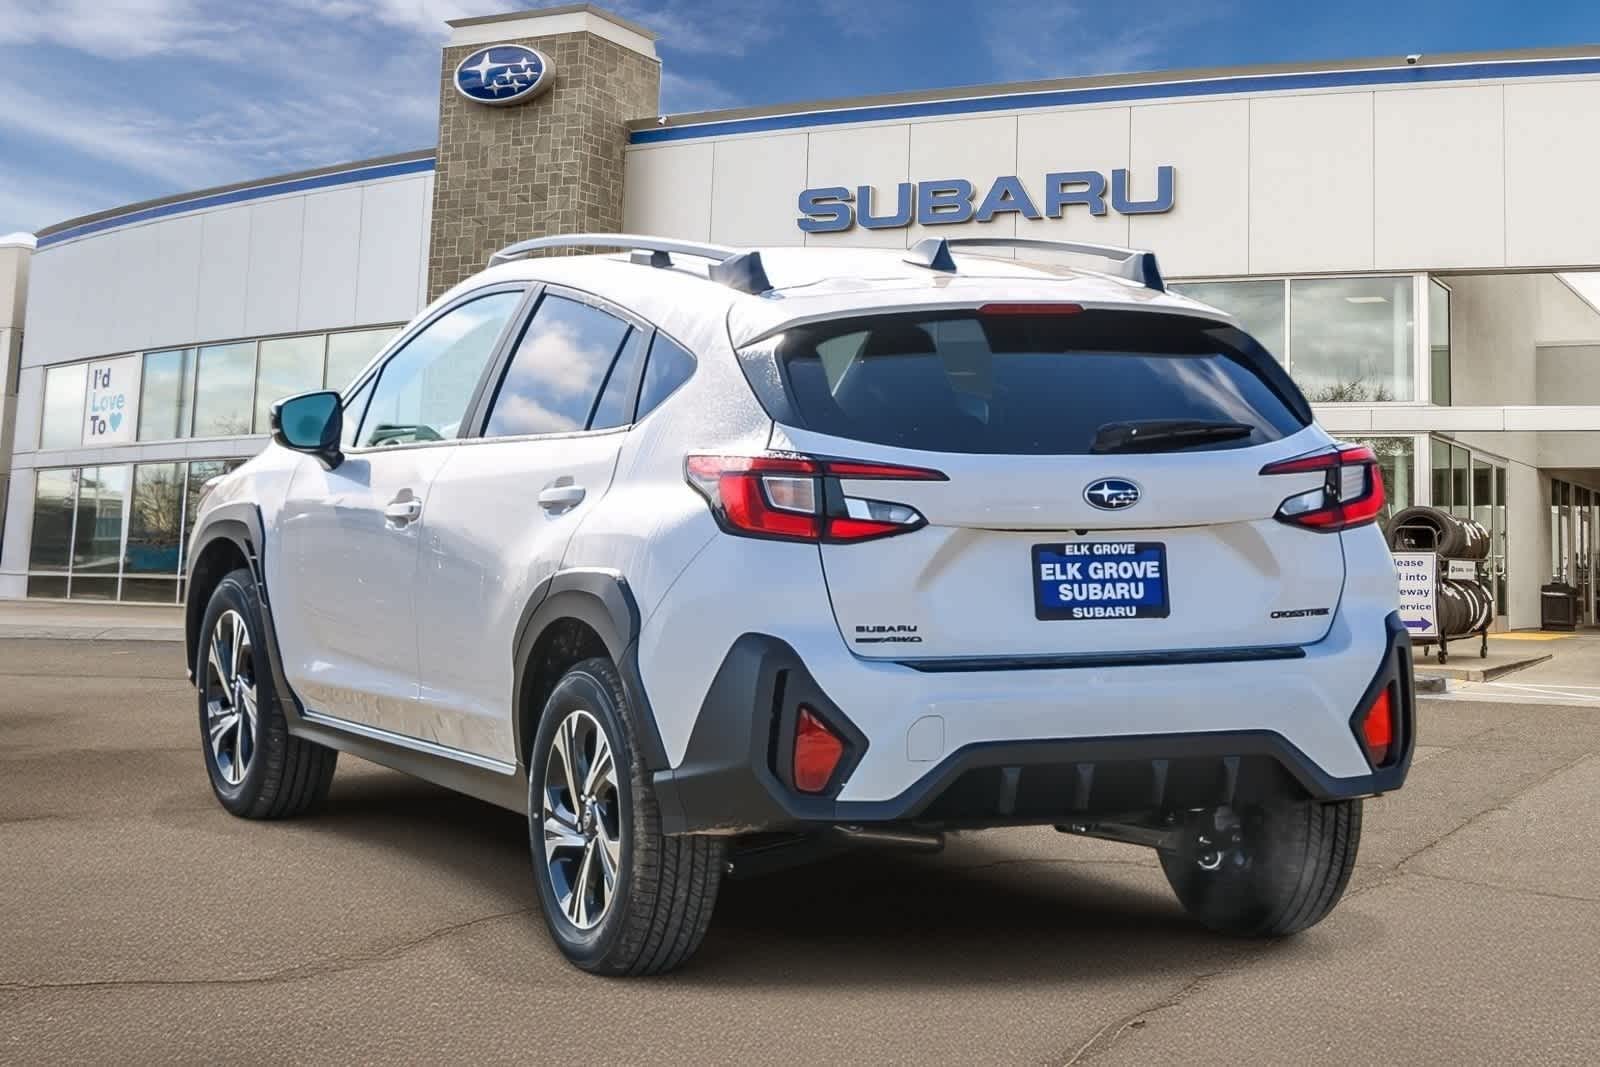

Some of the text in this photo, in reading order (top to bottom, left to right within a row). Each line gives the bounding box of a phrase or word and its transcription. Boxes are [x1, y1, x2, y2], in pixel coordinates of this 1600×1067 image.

[796, 165, 1176, 233] SUBARU
[93, 368, 111, 389] I'd
[91, 391, 125, 412] Love
[90, 415, 106, 435] To
[1065, 544, 1136, 556] ELK GROVE
[1394, 559, 1424, 567] lease
[1041, 561, 1160, 580] ELK GROVE
[1406, 573, 1428, 581] into
[1058, 582, 1145, 601] SUBARU
[1400, 588, 1430, 597] eway
[1072, 606, 1137, 618] SUBARU
[1400, 602, 1432, 611] ervice
[855, 625, 918, 633] SUBARU
